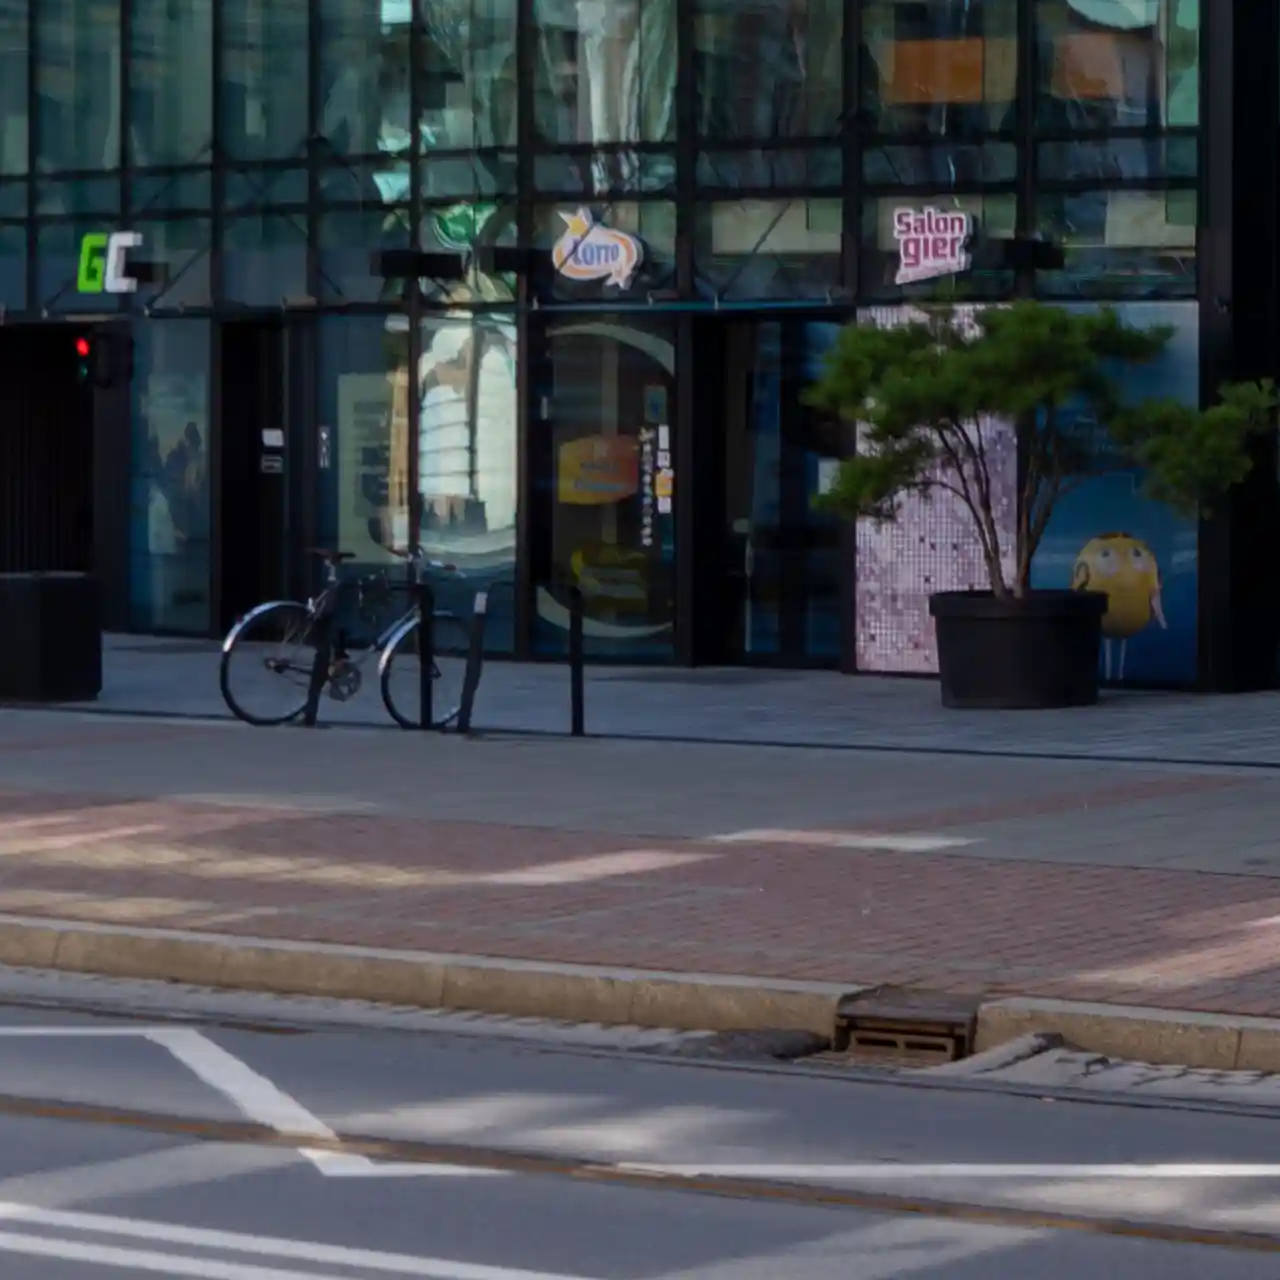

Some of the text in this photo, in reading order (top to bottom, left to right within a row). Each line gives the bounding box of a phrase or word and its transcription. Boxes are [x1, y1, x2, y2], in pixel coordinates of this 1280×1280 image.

[896, 210, 964, 235] Salon
[77, 230, 143, 294] GC
[902, 237, 960, 268] gier
